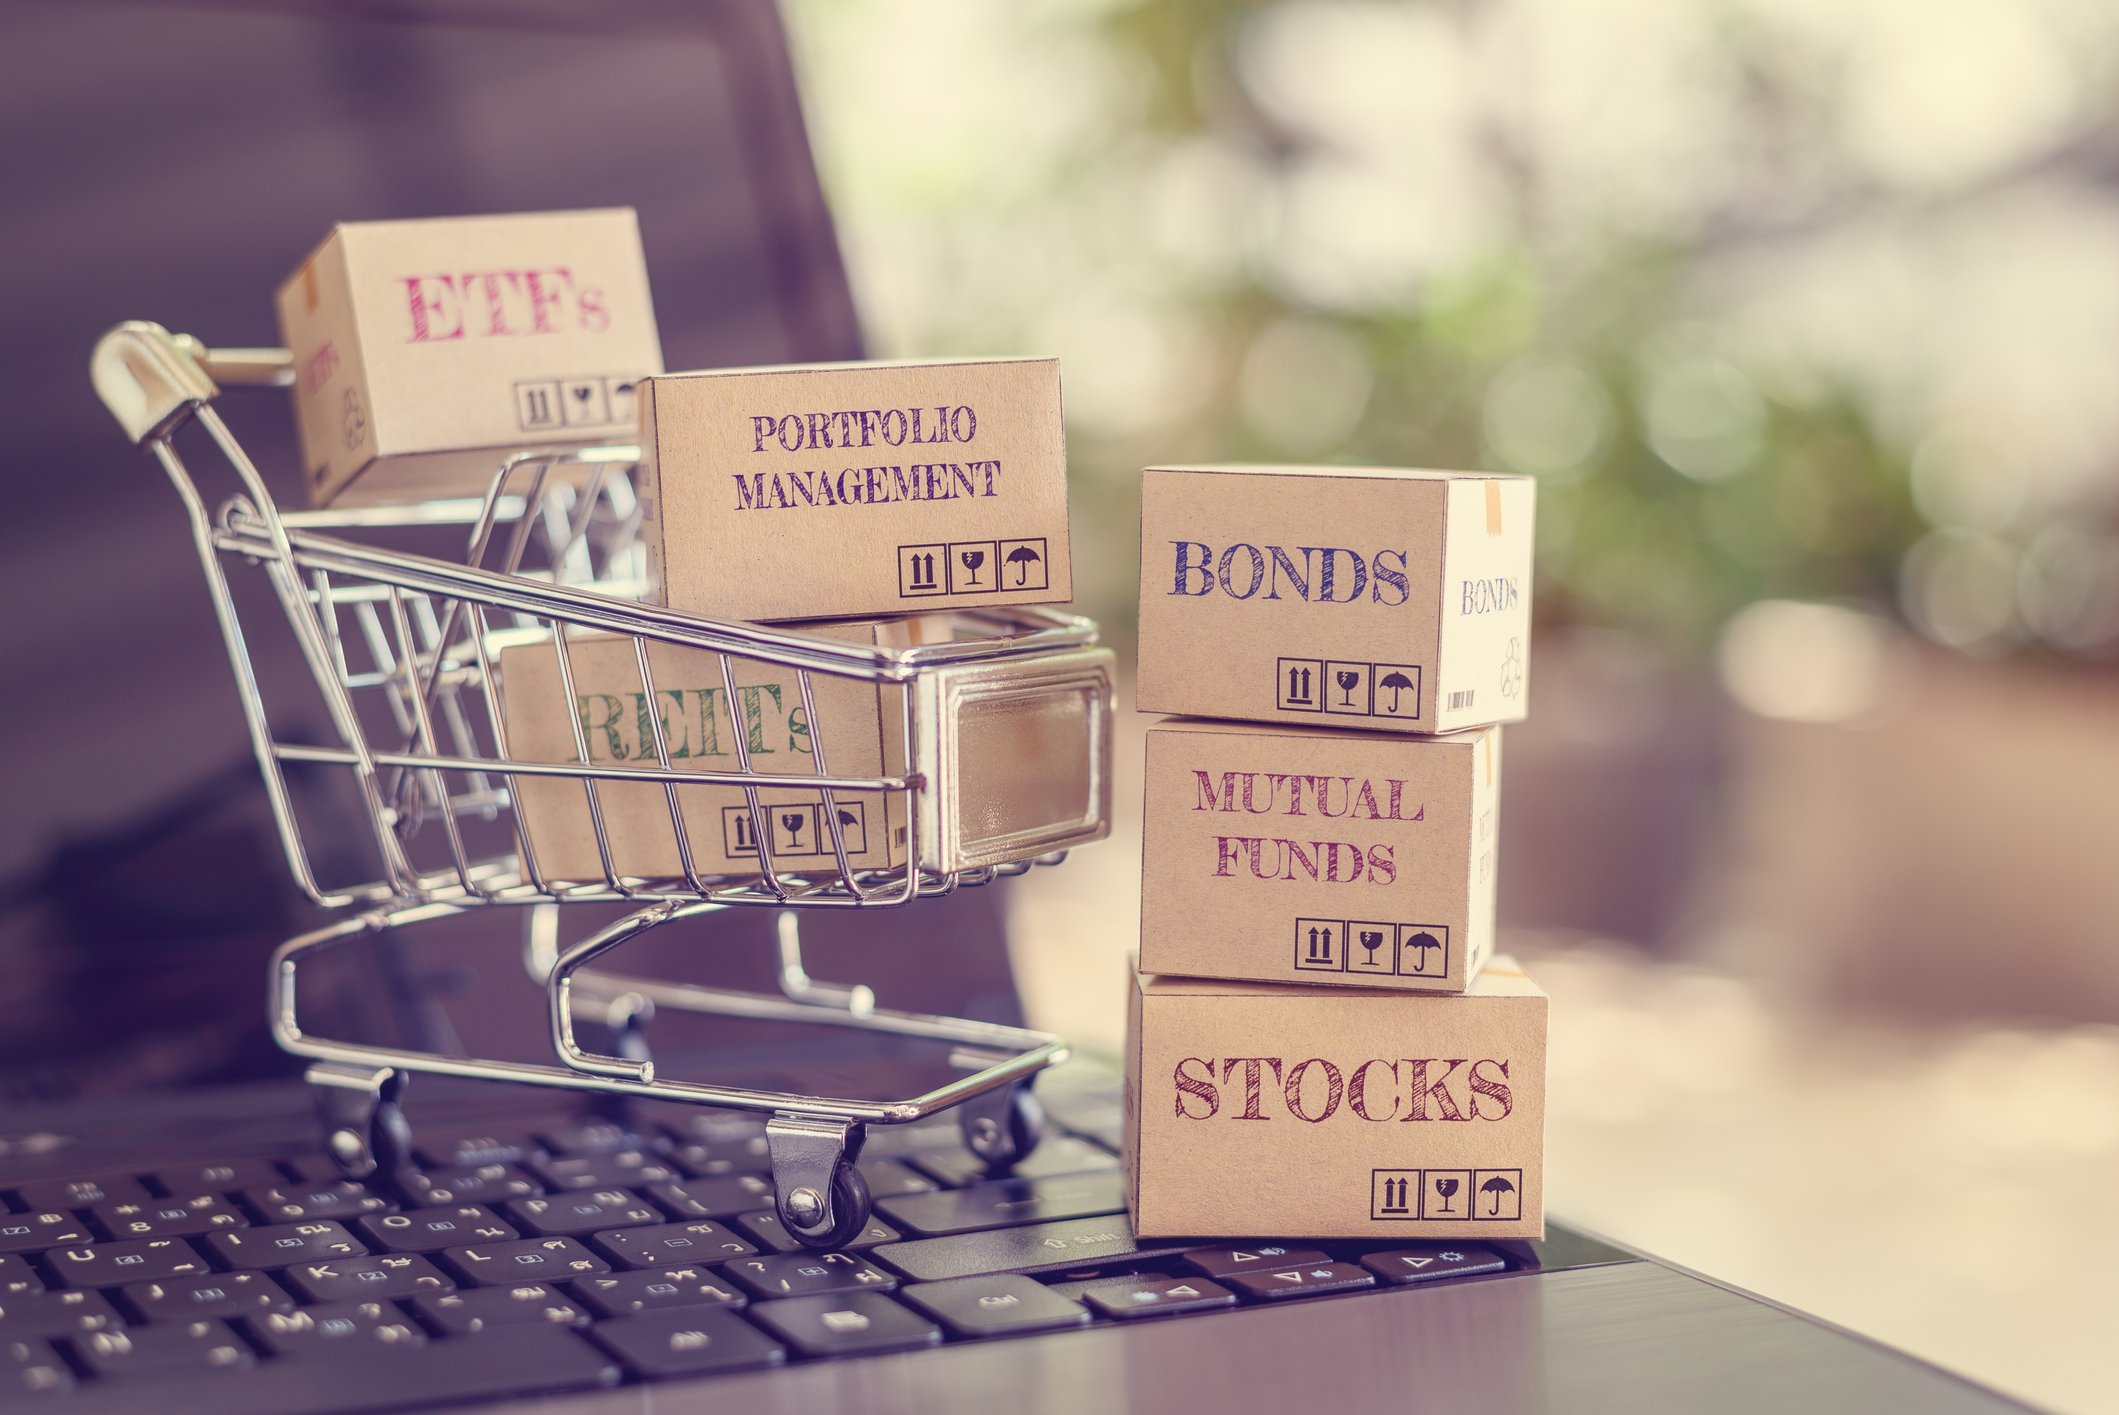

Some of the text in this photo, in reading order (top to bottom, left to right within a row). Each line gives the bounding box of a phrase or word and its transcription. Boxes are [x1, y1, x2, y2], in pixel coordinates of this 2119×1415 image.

[396, 266, 612, 344] ETFs
[750, 406, 977, 453] PORTFOLIO
[732, 460, 1001, 511] MANAGEMENT
[1167, 540, 1410, 606] BONDS
[1460, 577, 1518, 616] BONDS
[567, 684, 813, 763] REITs
[1191, 770, 1425, 822] MUTUAL
[1211, 836, 1397, 886] FUNDS
[1174, 1056, 1513, 1123] STOCKS
[130, 1221, 152, 1232] 8
[1074, 1231, 1122, 1245] Shift
[67, 1248, 96, 1262] U
[308, 1265, 340, 1280] K
[465, 1249, 492, 1261] L
